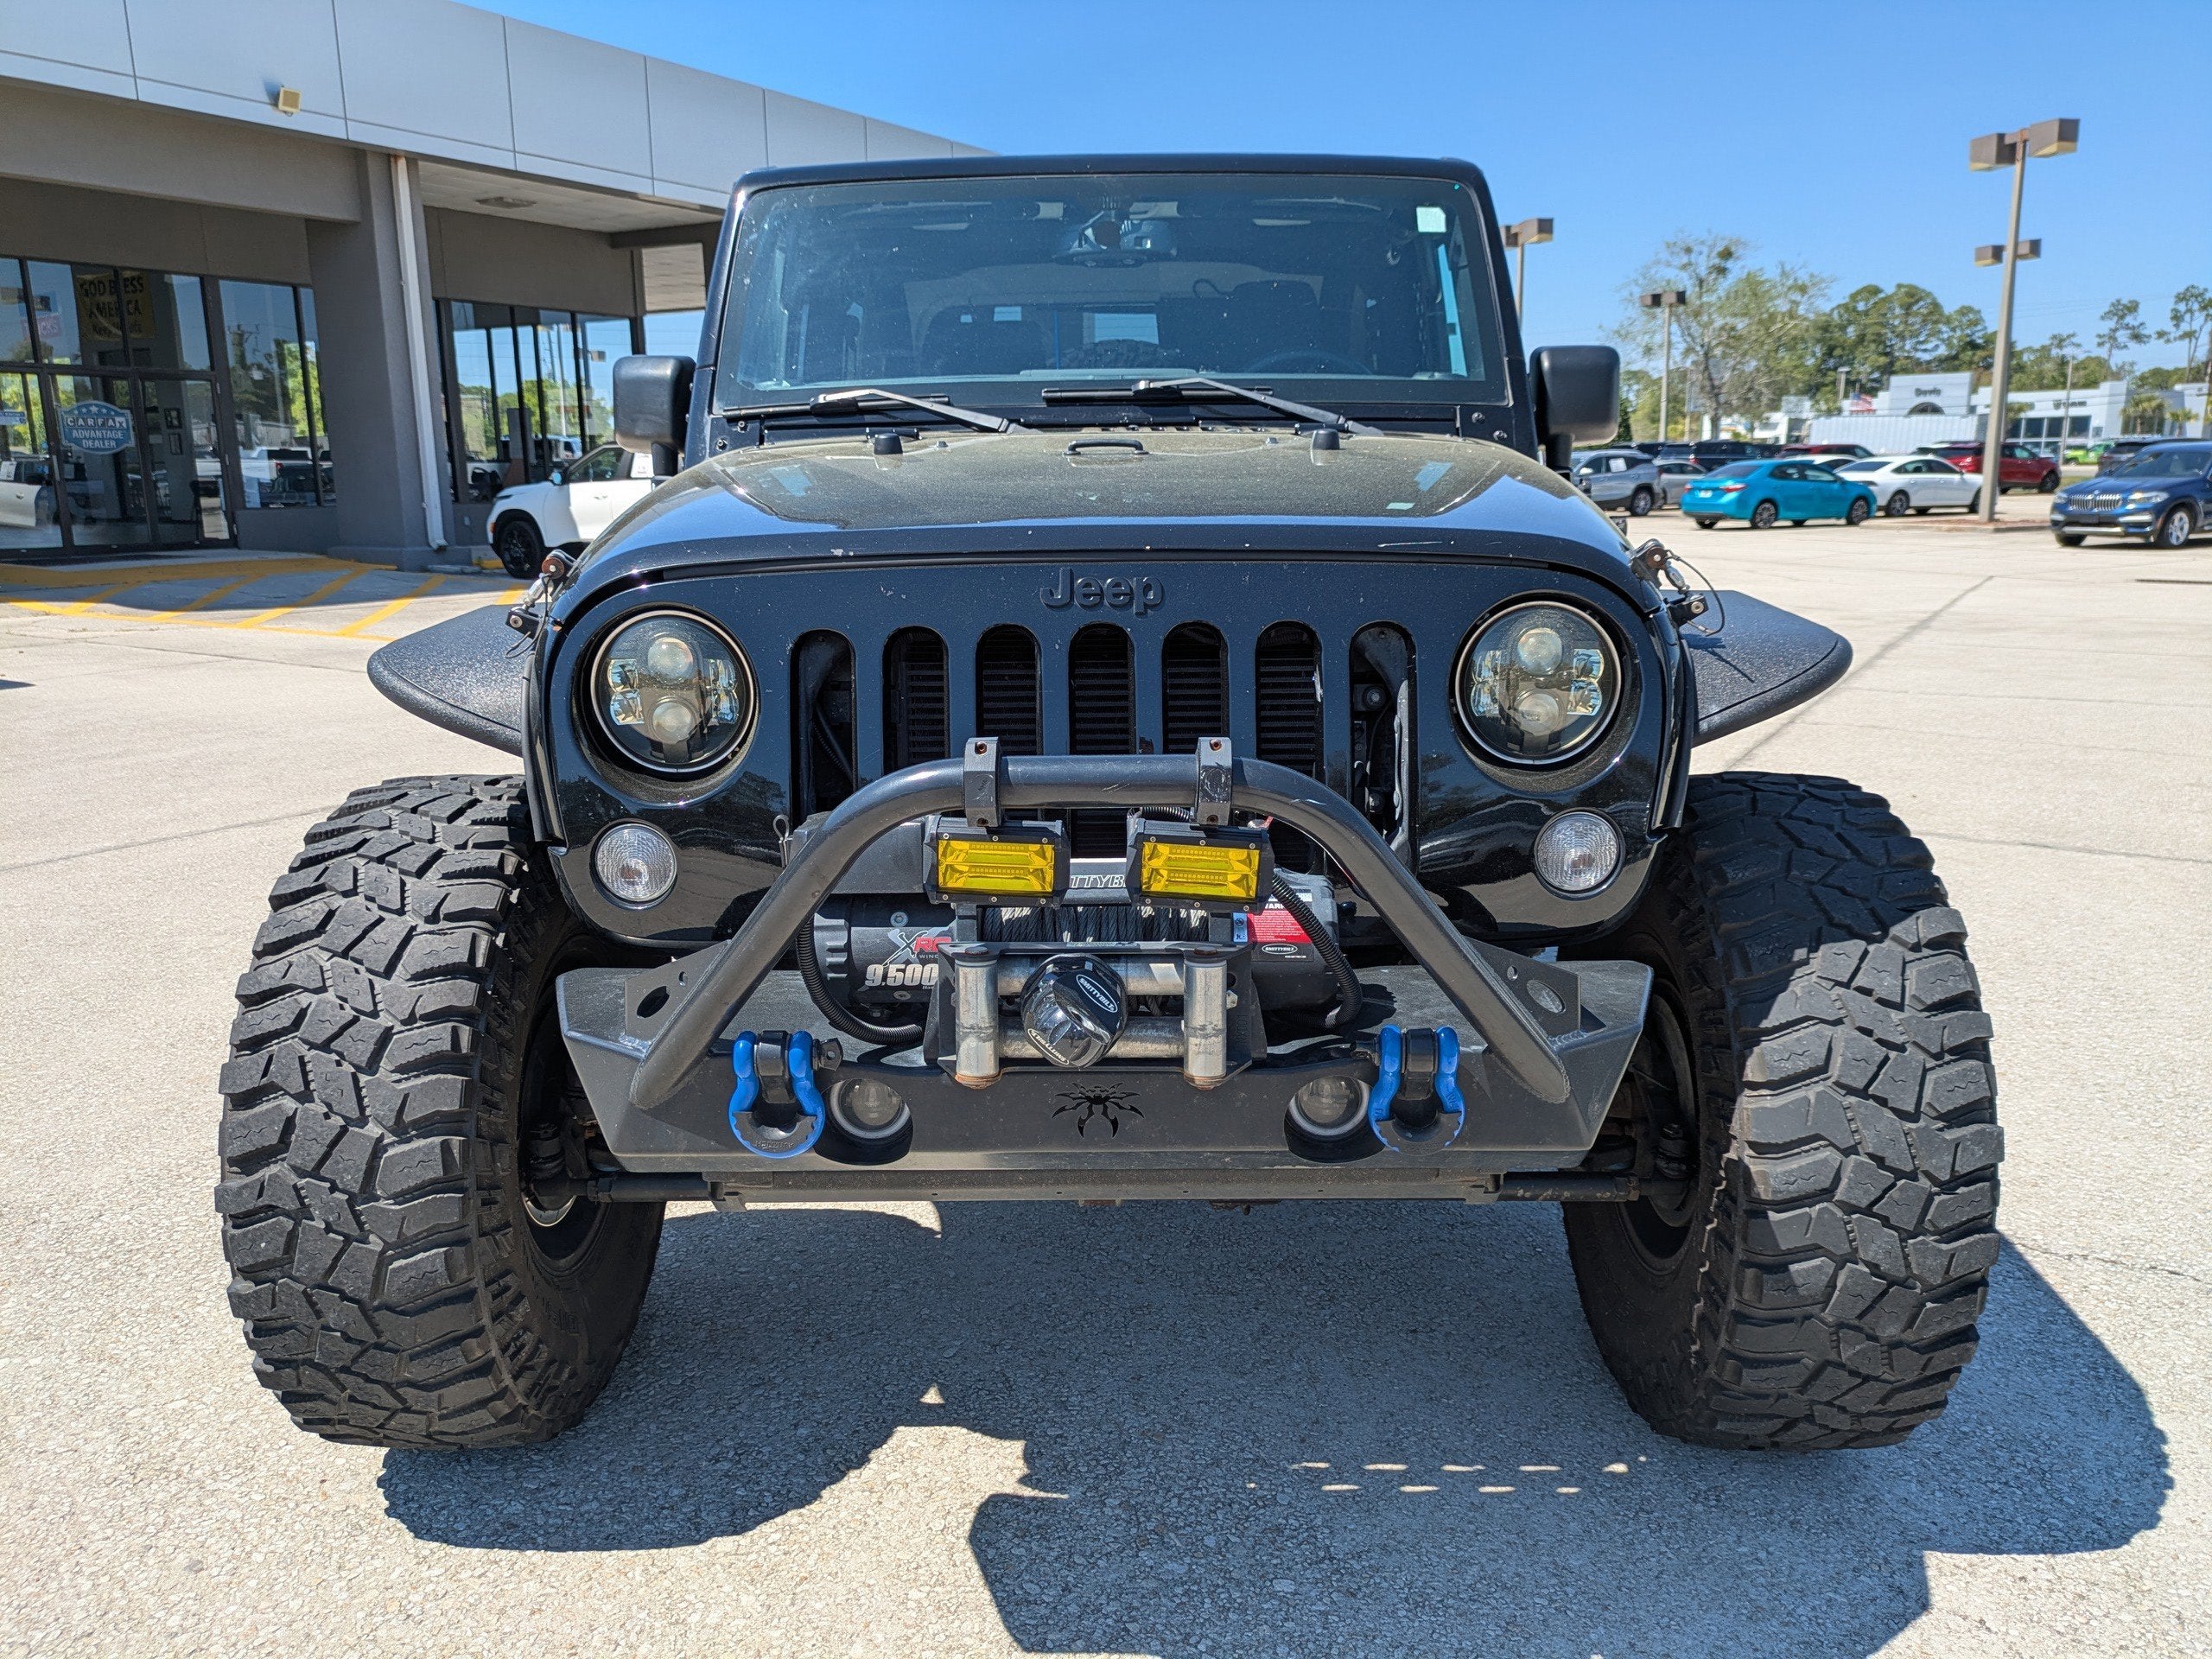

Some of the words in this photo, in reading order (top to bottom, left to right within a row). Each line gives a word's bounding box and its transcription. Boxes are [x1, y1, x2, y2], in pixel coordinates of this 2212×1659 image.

[109, 276, 144, 296] BESS
[67, 416, 126, 429] CARFAX
[73, 429, 124, 439] ADVANTAGE
[82, 440, 116, 448] DEALER
[1039, 567, 1164, 617] Jeep
